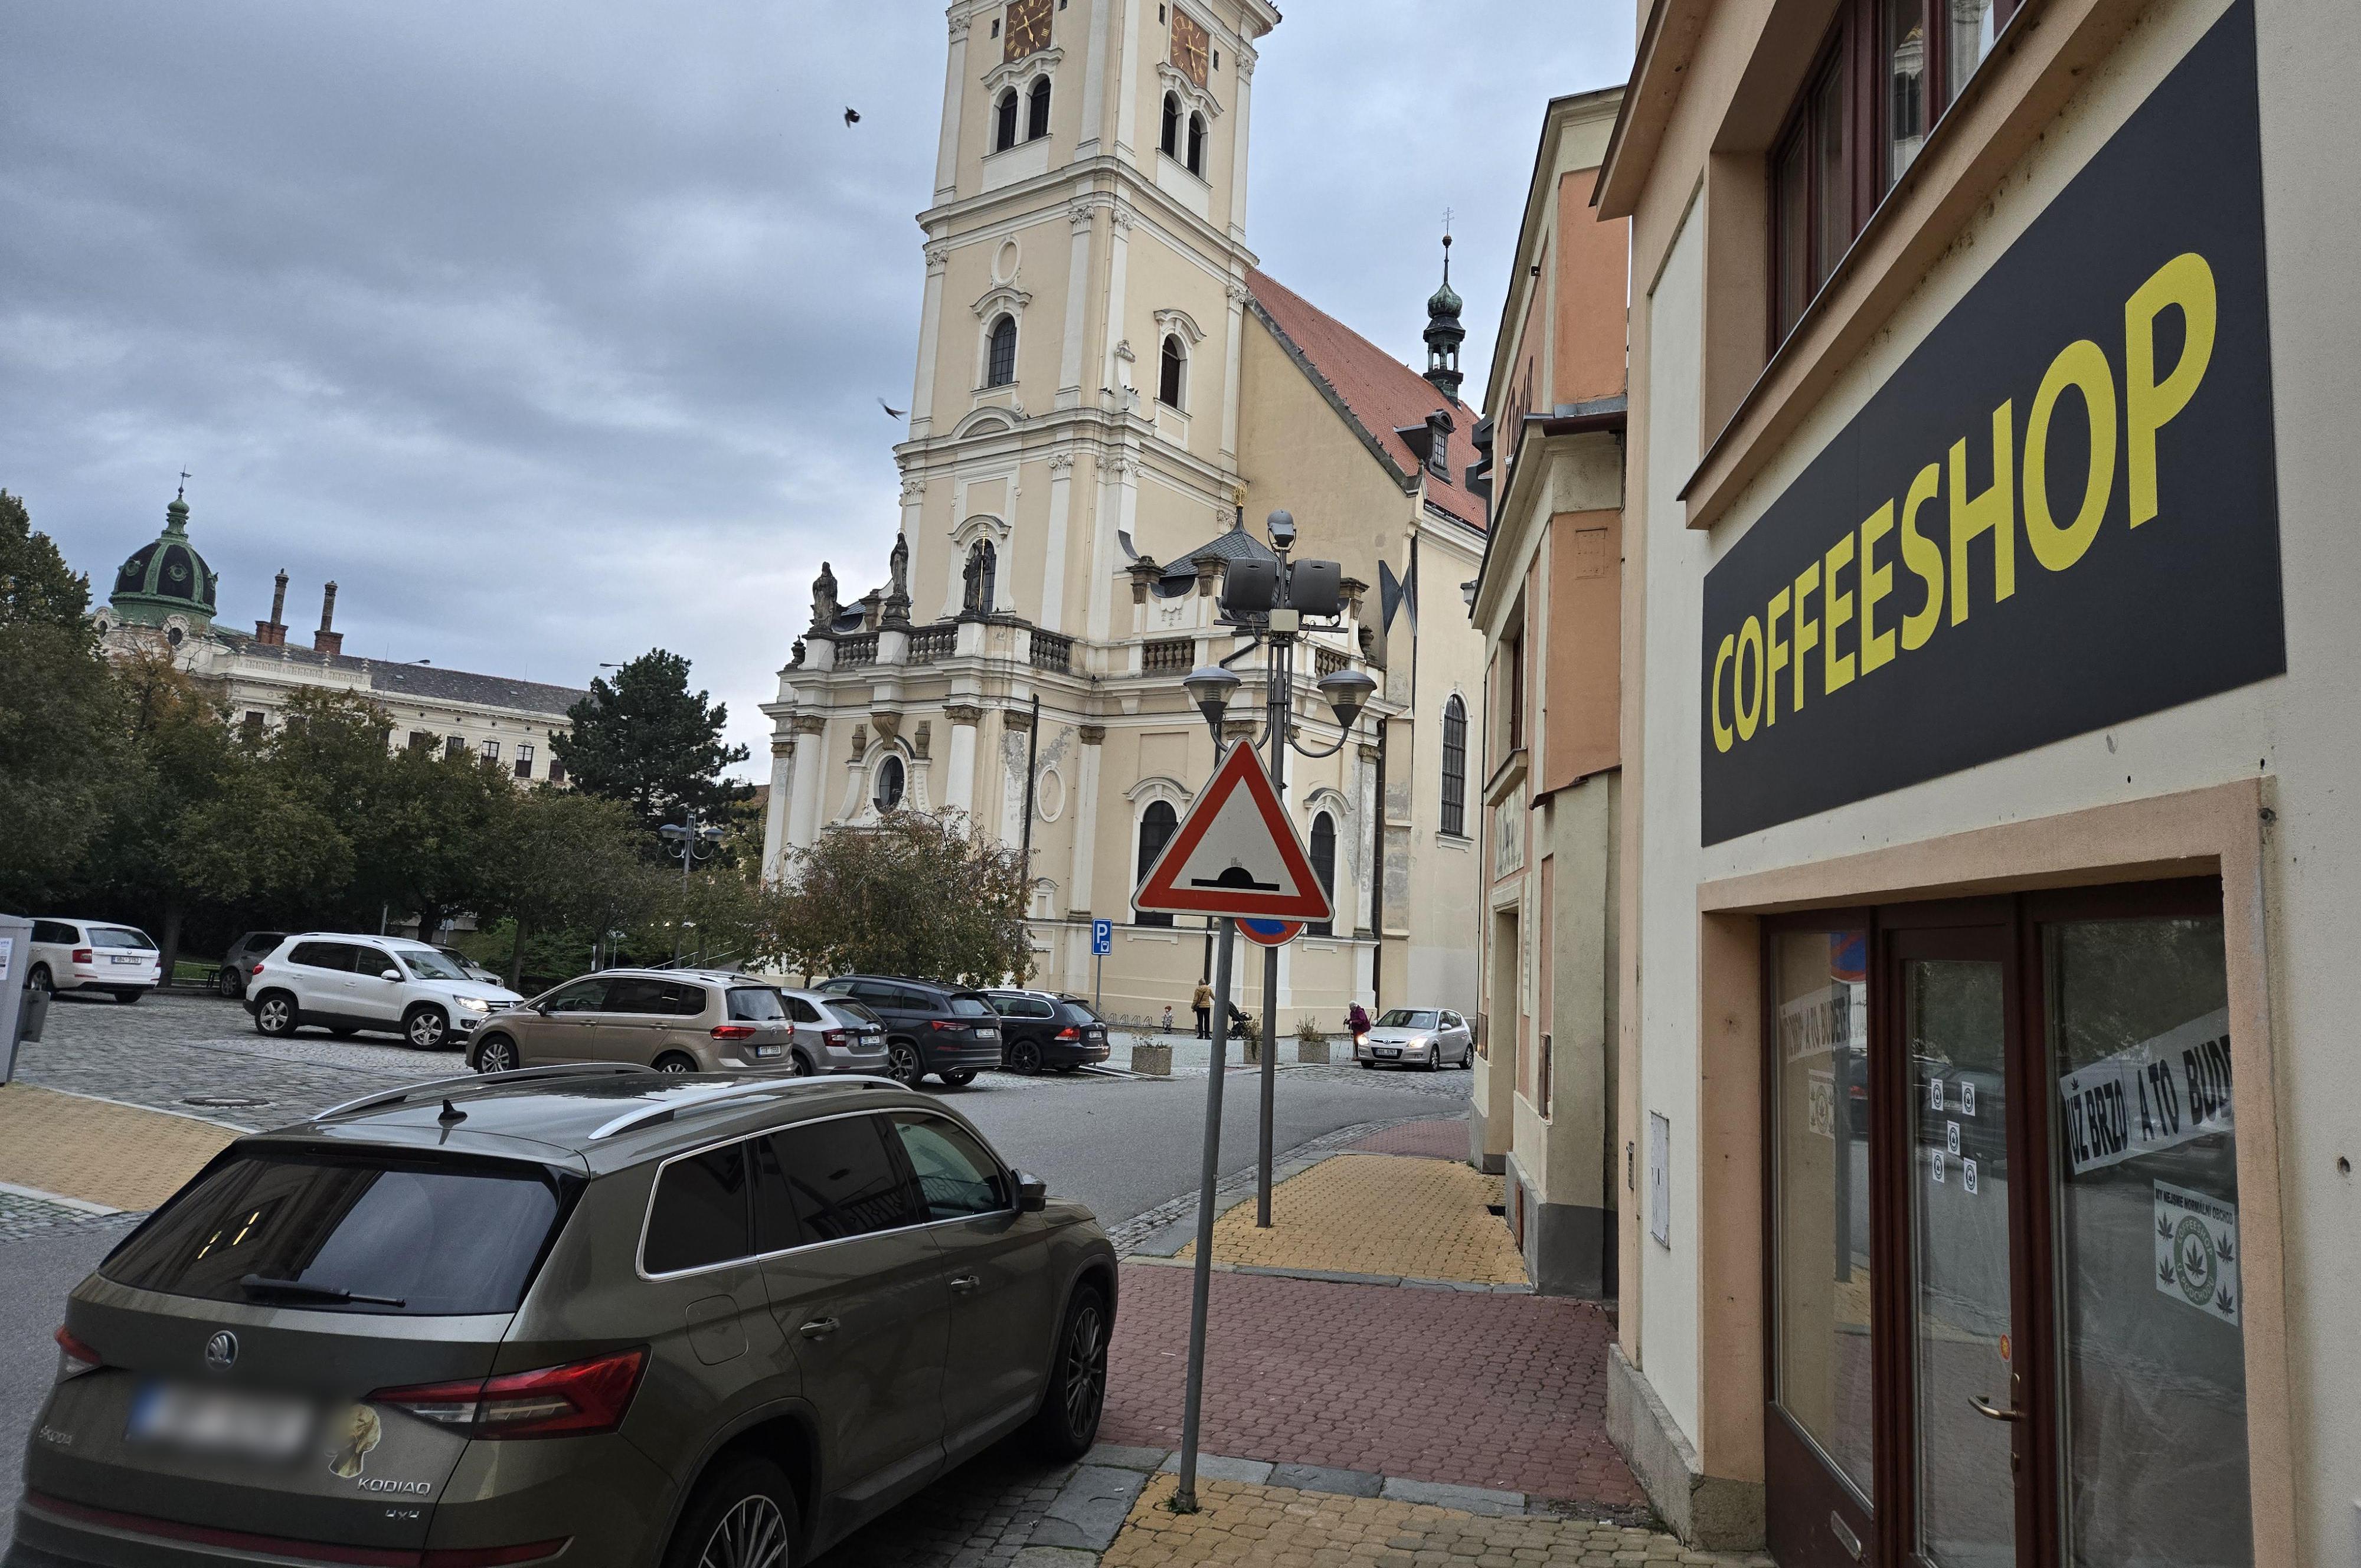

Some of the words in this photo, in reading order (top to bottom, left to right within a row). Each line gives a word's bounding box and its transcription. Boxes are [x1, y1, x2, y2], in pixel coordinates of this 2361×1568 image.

[1712, 252, 2217, 753] COFFEESHOP
[1097, 924, 1108, 944] P
[2085, 1079, 2127, 1158] BRZO
[2137, 1069, 2156, 1141] A
[2147, 1059, 2179, 1136] TO
[2156, 1188, 2163, 1201] MY
[357, 1478, 431, 1496] KODIAQ
